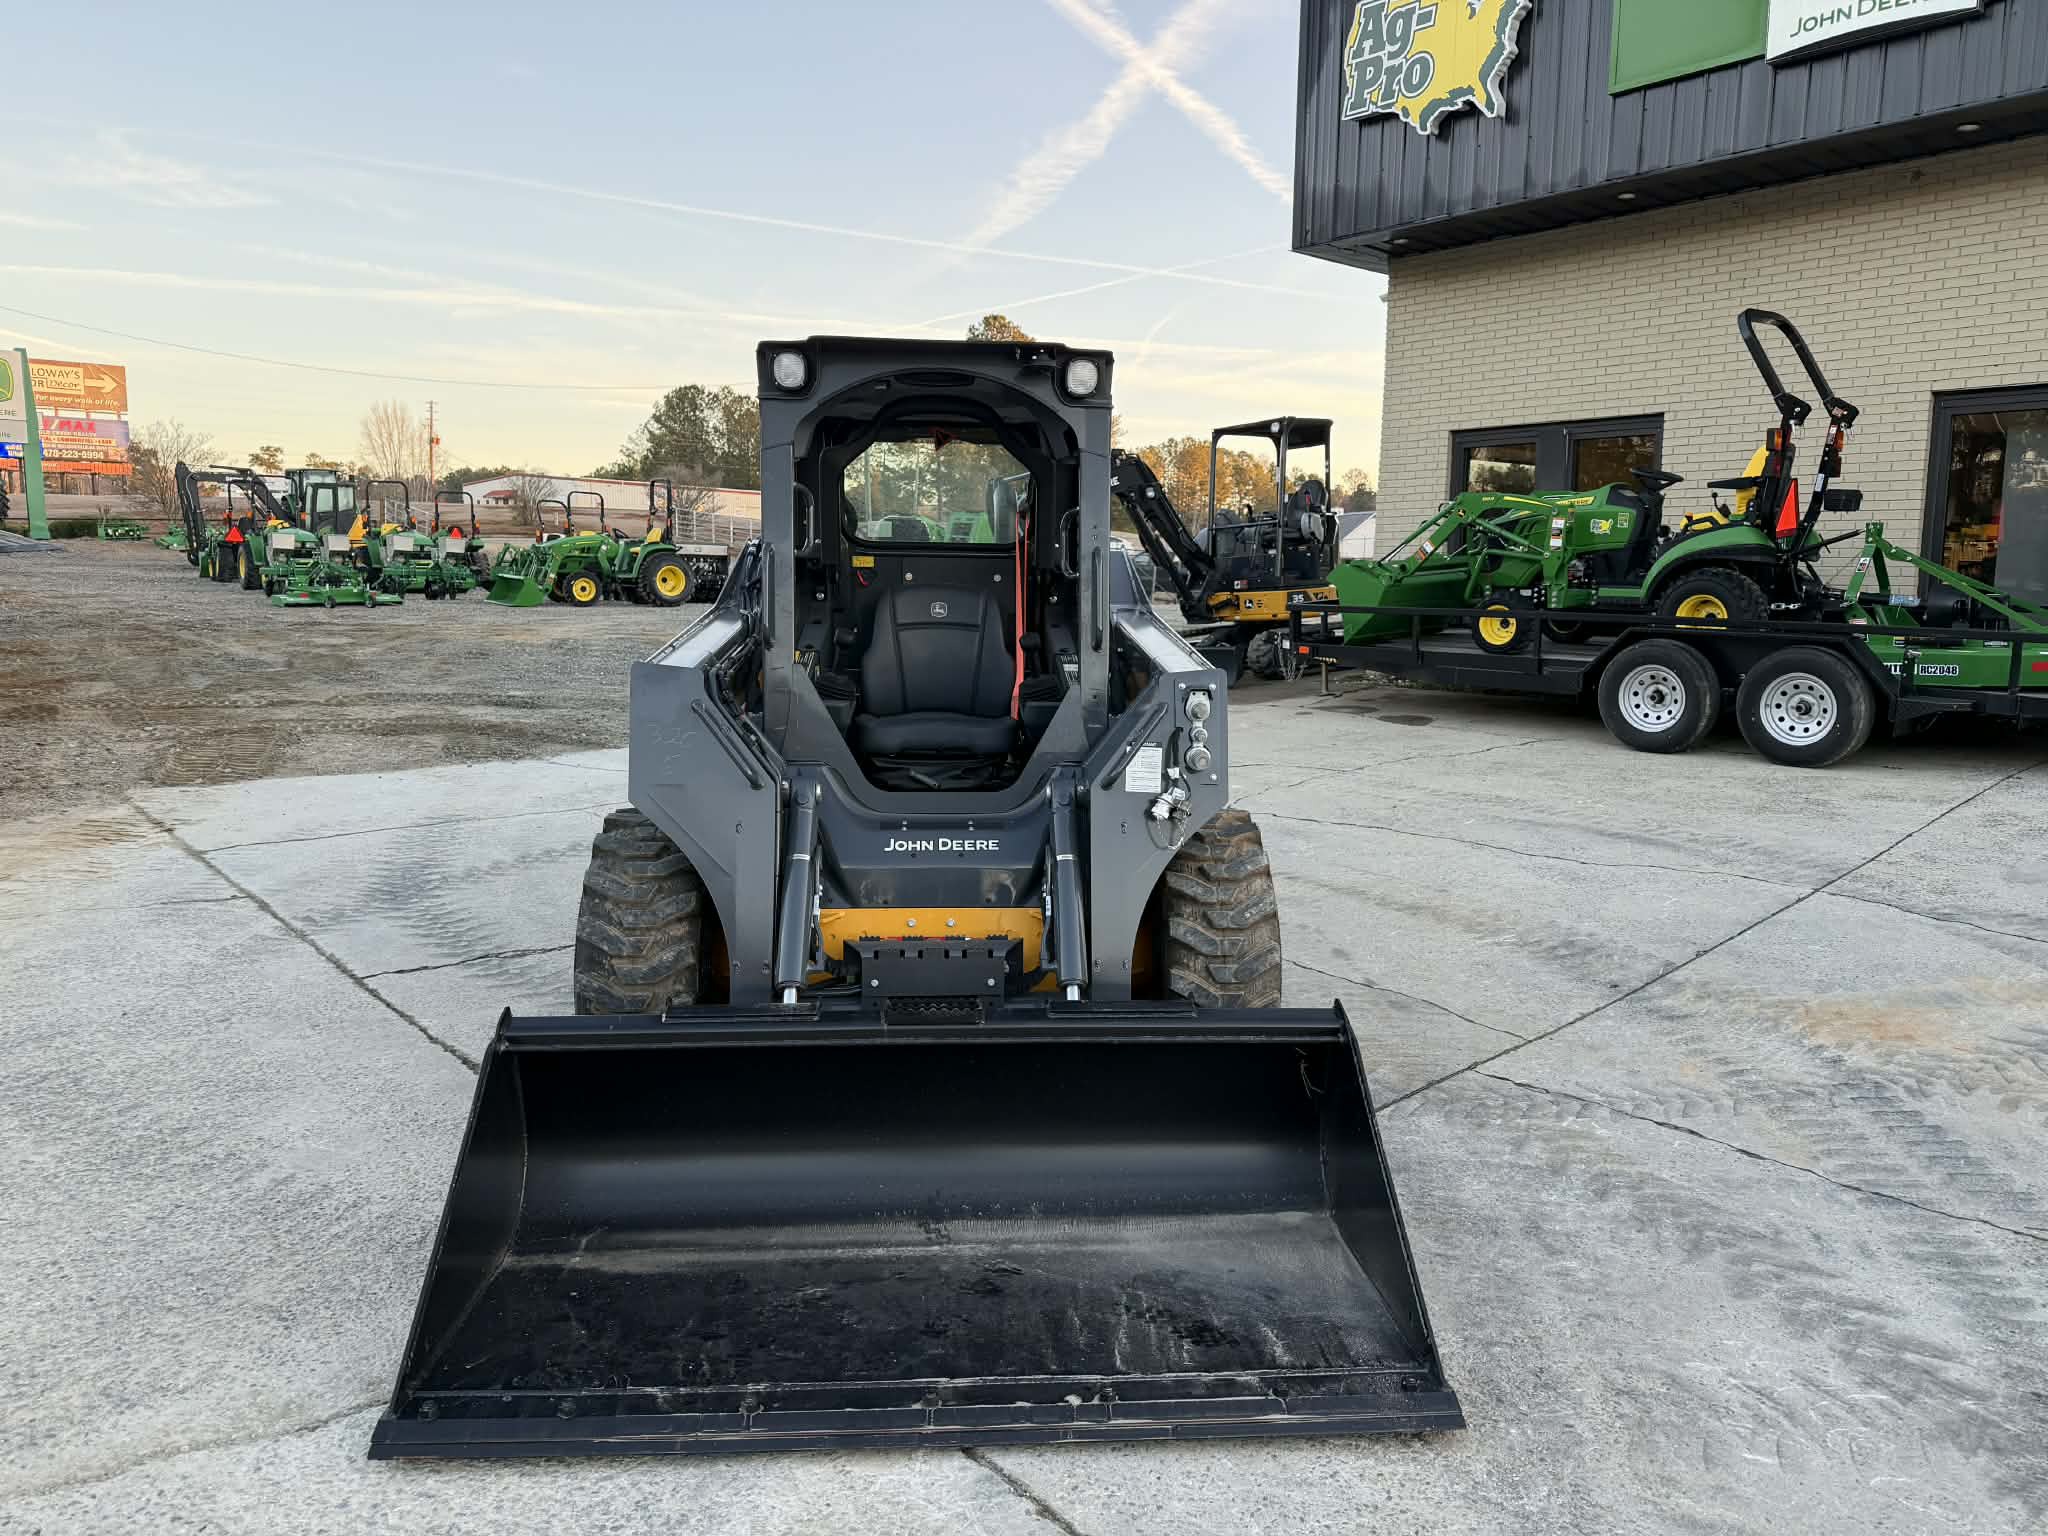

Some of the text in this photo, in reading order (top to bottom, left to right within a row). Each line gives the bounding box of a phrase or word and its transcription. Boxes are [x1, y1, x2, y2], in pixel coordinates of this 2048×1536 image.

[1349, 0, 1438, 62] Ag-
[1790, 5, 1852, 38] JOHN
[1344, 52, 1435, 118] Pro
[1919, 664, 1959, 676] RC2048
[884, 837, 1000, 852] JOHN DEERE
